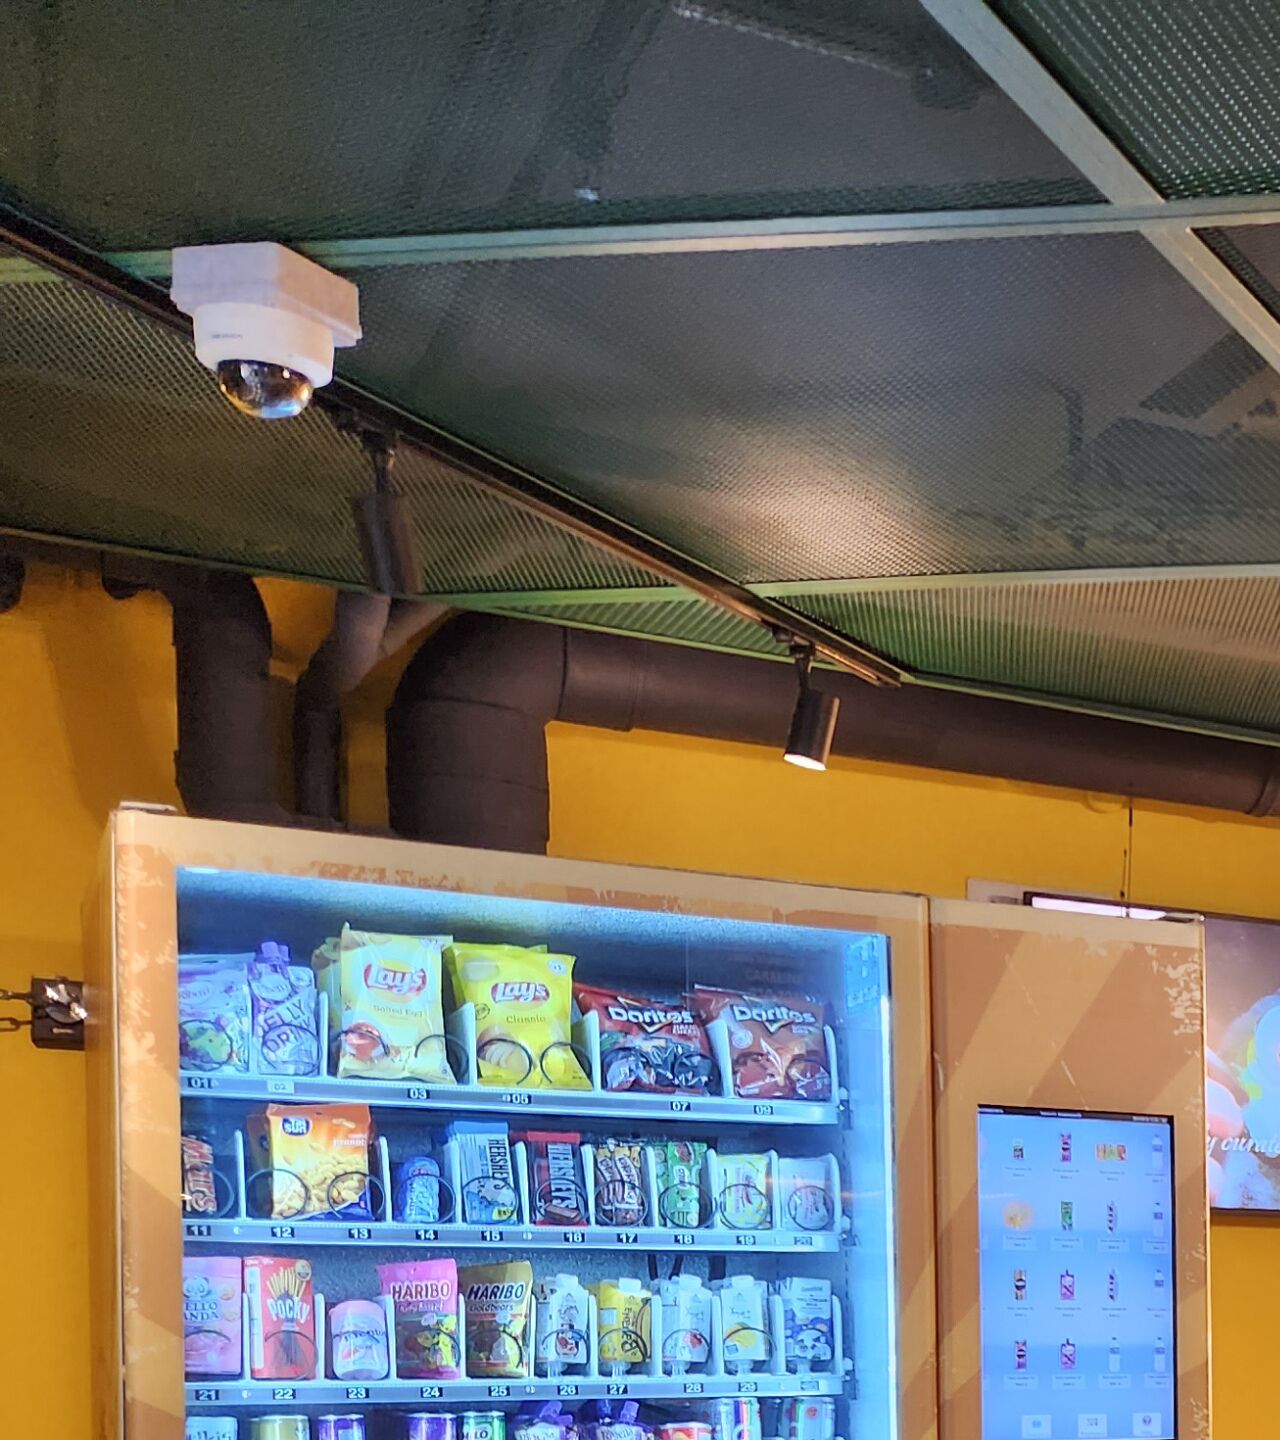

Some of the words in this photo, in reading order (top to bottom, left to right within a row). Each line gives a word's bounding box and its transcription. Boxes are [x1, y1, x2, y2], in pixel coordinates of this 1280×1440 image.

[492, 981, 550, 1004] Lay's
[607, 1005, 695, 1024] Doritos
[733, 1003, 817, 1024] Doritos
[409, 1089, 427, 1099] 03
[512, 1094, 529, 1104] 05
[672, 1101, 689, 1111] 07
[755, 1105, 772, 1115] 09
[190, 1225, 209, 1236] 11
[273, 1227, 292, 1238] 12
[350, 1228, 369, 1239] 13
[417, 1230, 436, 1241] 14
[483, 1232, 501, 1242] 15
[619, 1234, 635, 1244] 17
[676, 1235, 693, 1245] 18
[738, 1236, 754, 1246] 19
[391, 1283, 450, 1300] HARIBO
[466, 1283, 525, 1300] HARIBO
[184, 1300, 218, 1311] ELLO
[184, 1311, 219, 1321] ANDA
[267, 1300, 311, 1324] POCKY
[422, 1387, 441, 1398] 24
[490, 1386, 508, 1396] 25
[559, 1385, 577, 1395] 26
[608, 1384, 626, 1395] 27
[685, 1383, 702, 1394] 28
[739, 1382, 756, 1392] 29
[199, 1389, 216, 1400] 21
[275, 1389, 294, 1399] 22
[349, 1388, 367, 1399] 23
